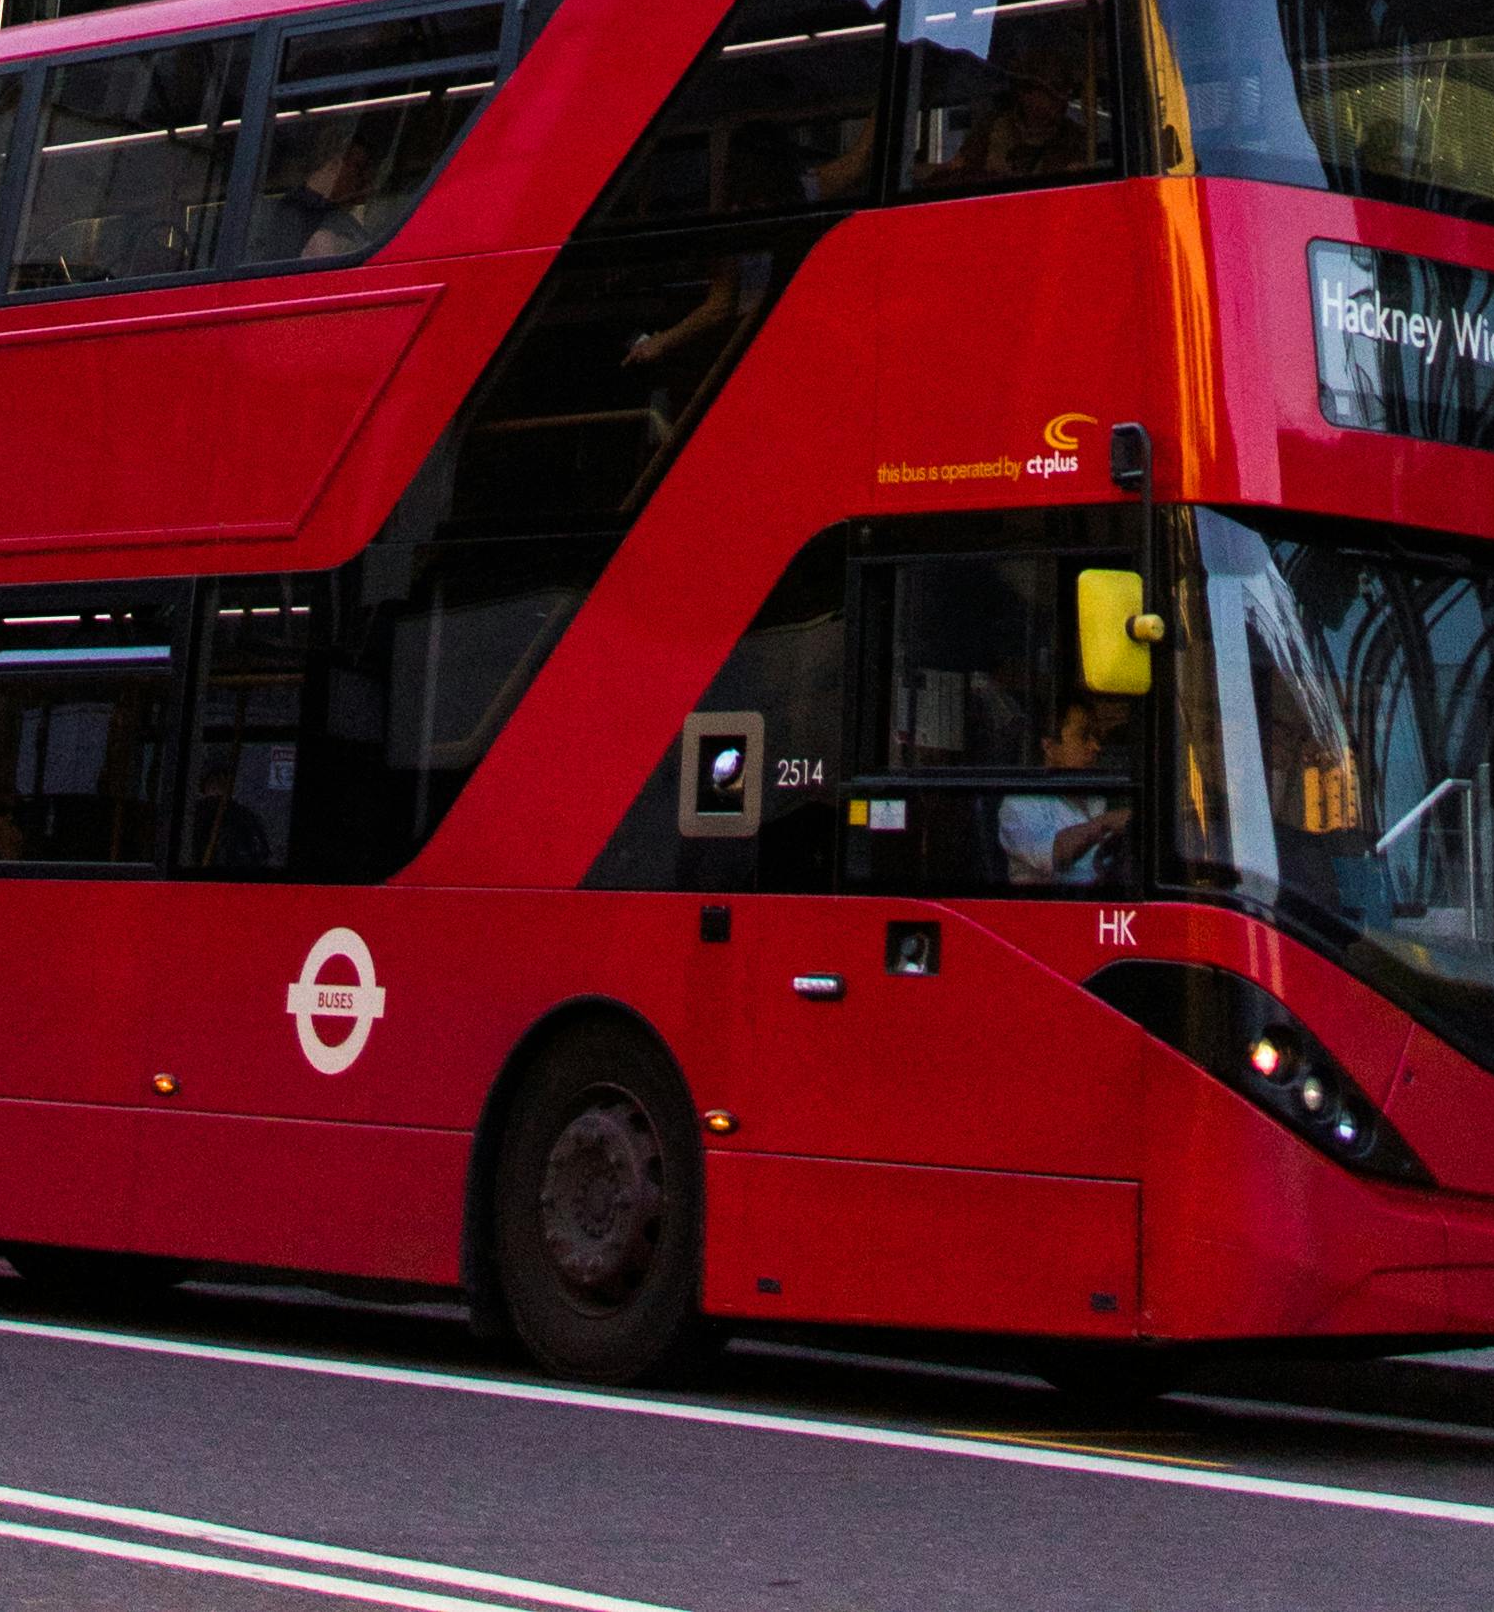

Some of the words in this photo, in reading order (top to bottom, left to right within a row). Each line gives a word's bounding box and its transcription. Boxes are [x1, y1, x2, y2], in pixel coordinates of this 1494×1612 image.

[1322, 278, 1443, 365] Hackney
[878, 463, 900, 484] this
[901, 462, 926, 482] bus
[928, 463, 938, 481] is
[940, 456, 1002, 484] operated
[1004, 455, 1022, 482] by
[778, 758, 824, 786] 2514
[1099, 909, 1137, 946] HK
[318, 992, 354, 1009] BUSES
